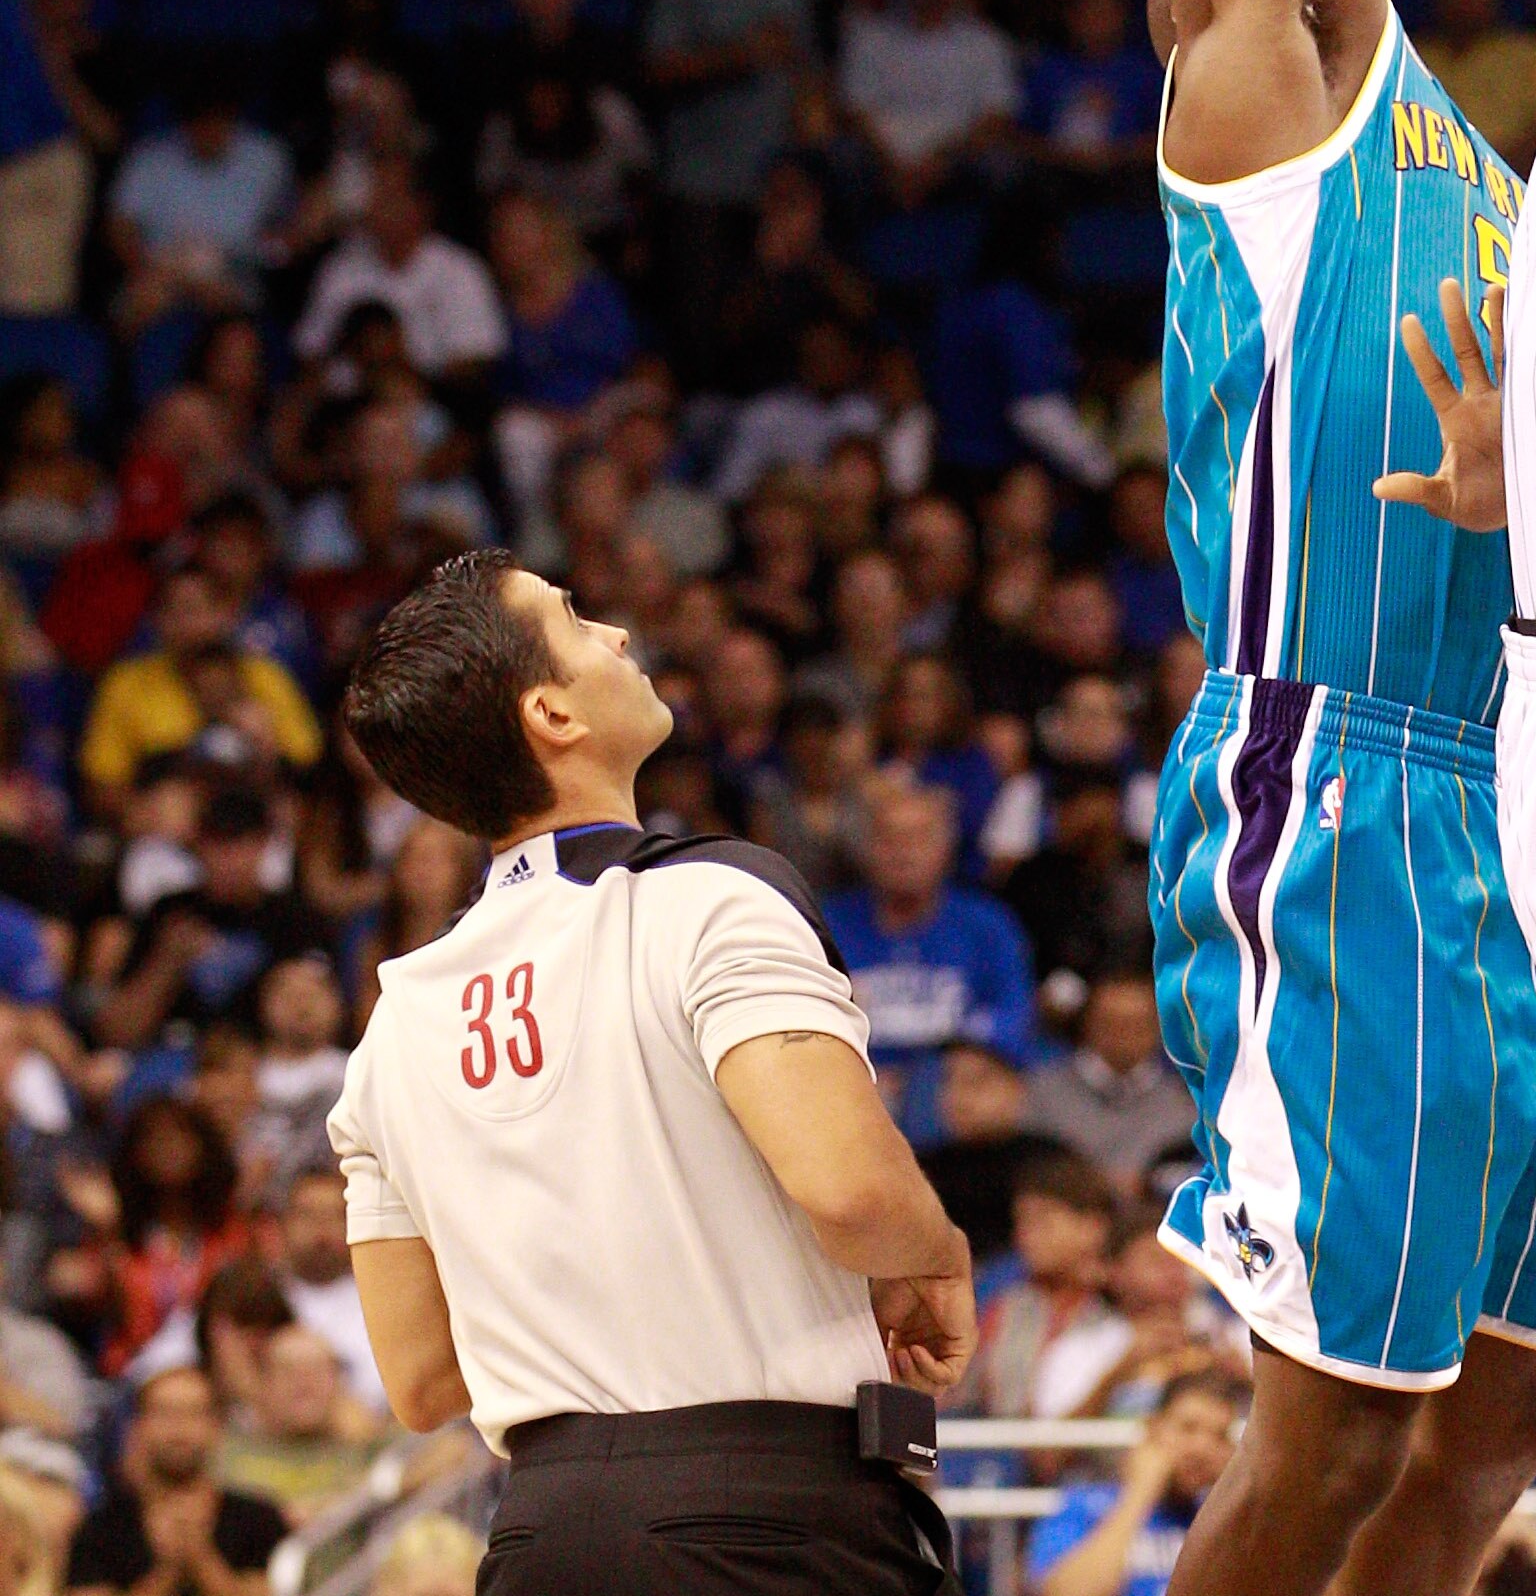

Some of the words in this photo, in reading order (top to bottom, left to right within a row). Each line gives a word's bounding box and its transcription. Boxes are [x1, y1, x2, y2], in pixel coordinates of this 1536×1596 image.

[1392, 101, 1478, 187] NEW
[497, 870, 536, 889] adidas
[460, 961, 544, 1090] 33
